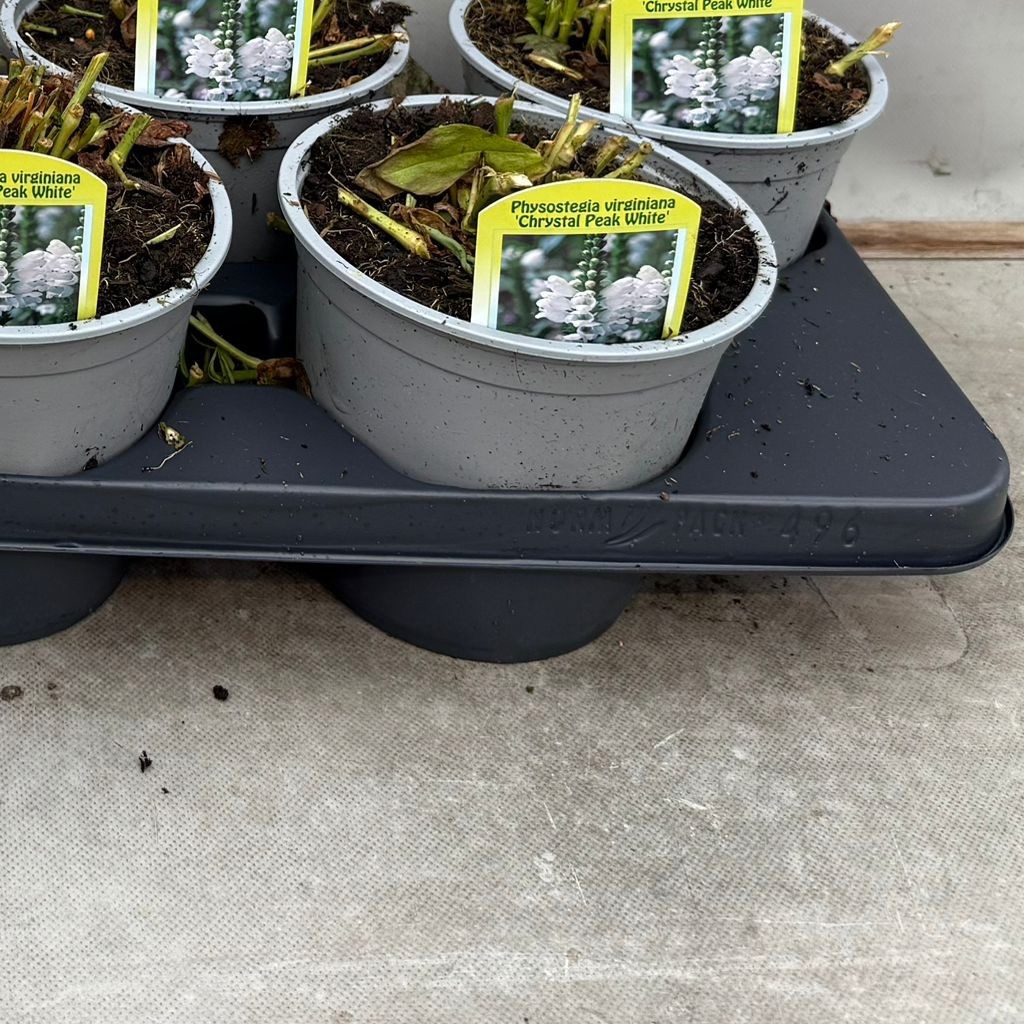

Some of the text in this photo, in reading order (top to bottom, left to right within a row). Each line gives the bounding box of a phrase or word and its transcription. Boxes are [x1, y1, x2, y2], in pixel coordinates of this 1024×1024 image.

[642, 0, 698, 12] 'Chrystal
[11, 170, 81, 185] virginiana
[31, 184, 76, 199] White'
[511, 197, 676, 214] Physostegia virginiana
[516, 210, 670, 228] 'Chrystal Peak White'
